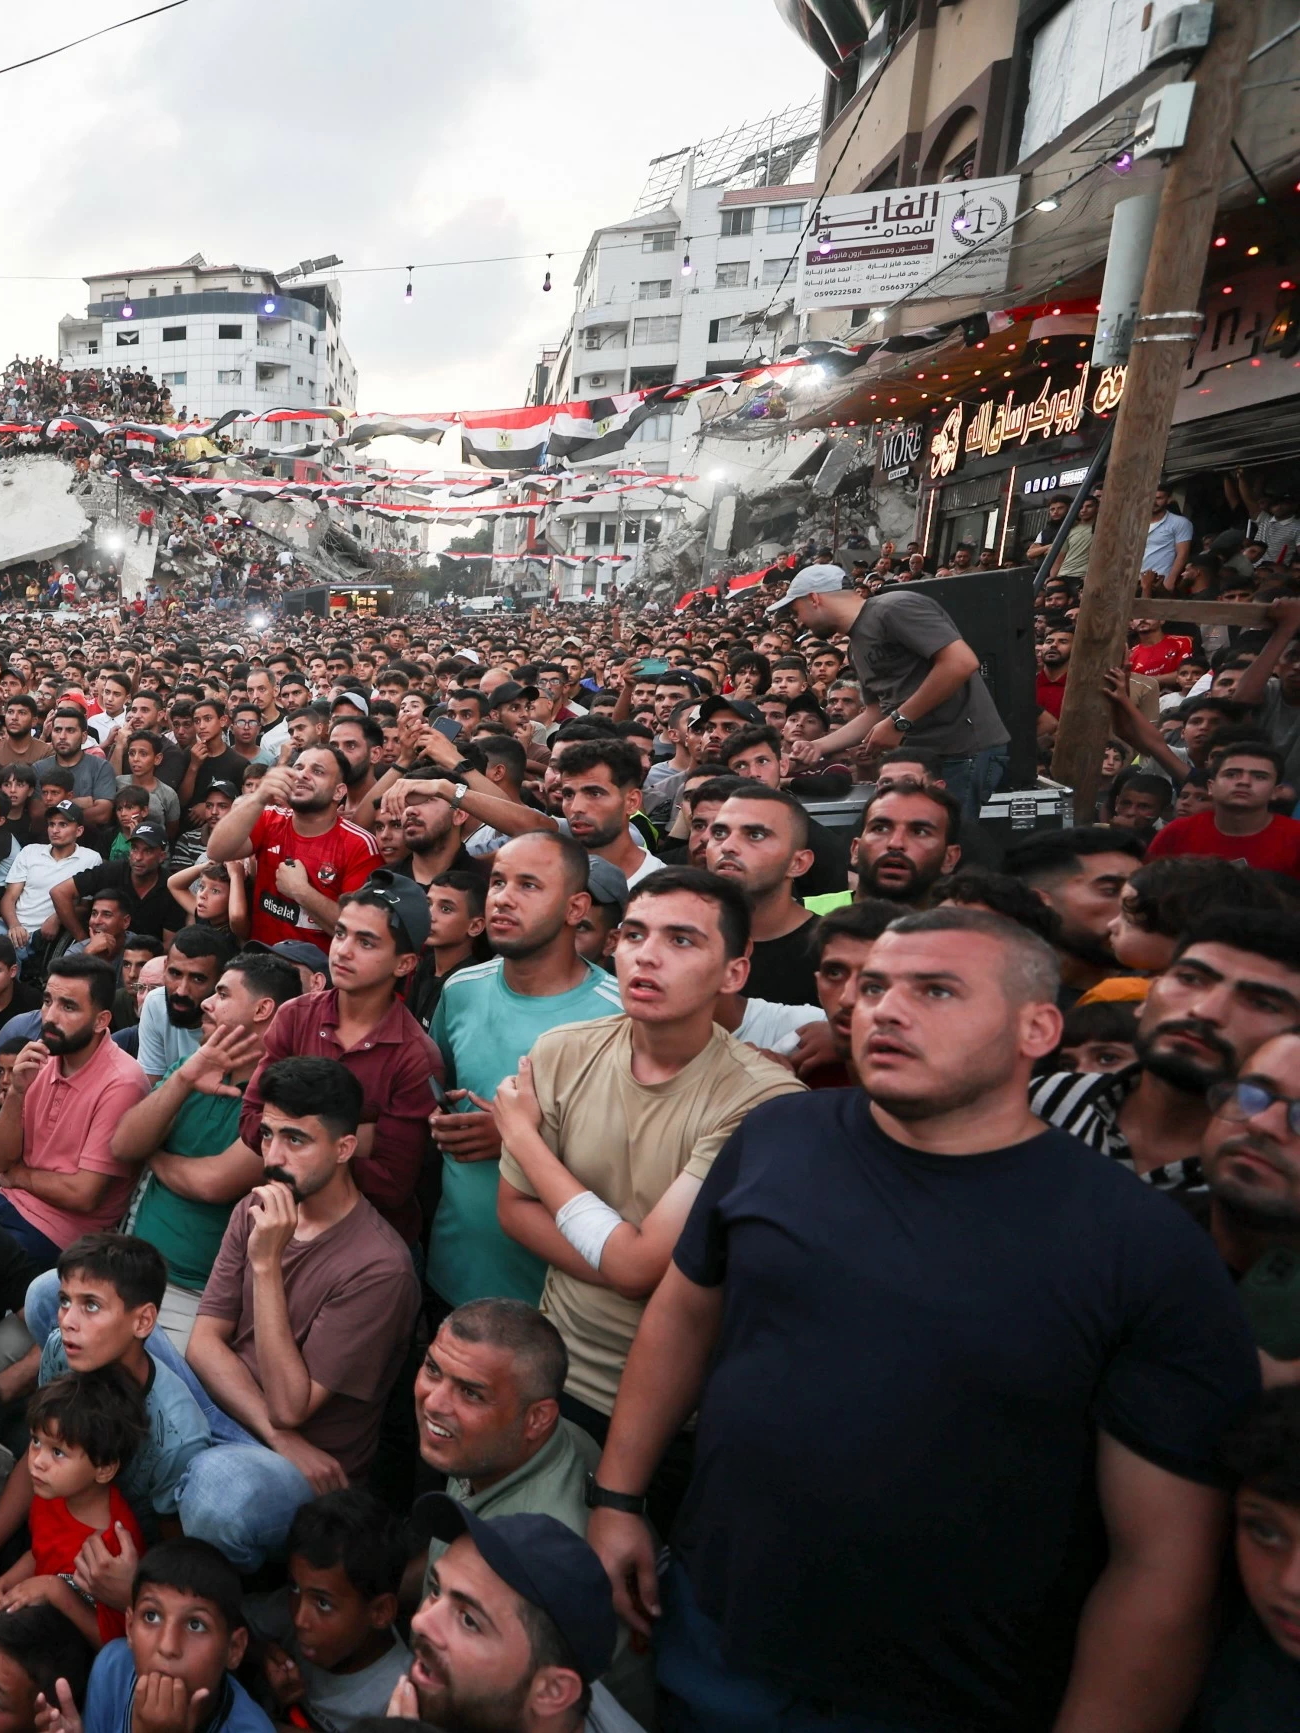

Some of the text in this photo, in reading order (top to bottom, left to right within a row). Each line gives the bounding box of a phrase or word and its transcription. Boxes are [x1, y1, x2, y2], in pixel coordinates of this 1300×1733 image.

[809, 191, 940, 236] الفايز
[848, 247, 895, 258] ومستشارون
[895, 244, 929, 254] محامون
[814, 288, 862, 298] 0599222582
[879, 423, 923, 471] MORE
[263, 898, 296, 921] etisalat
